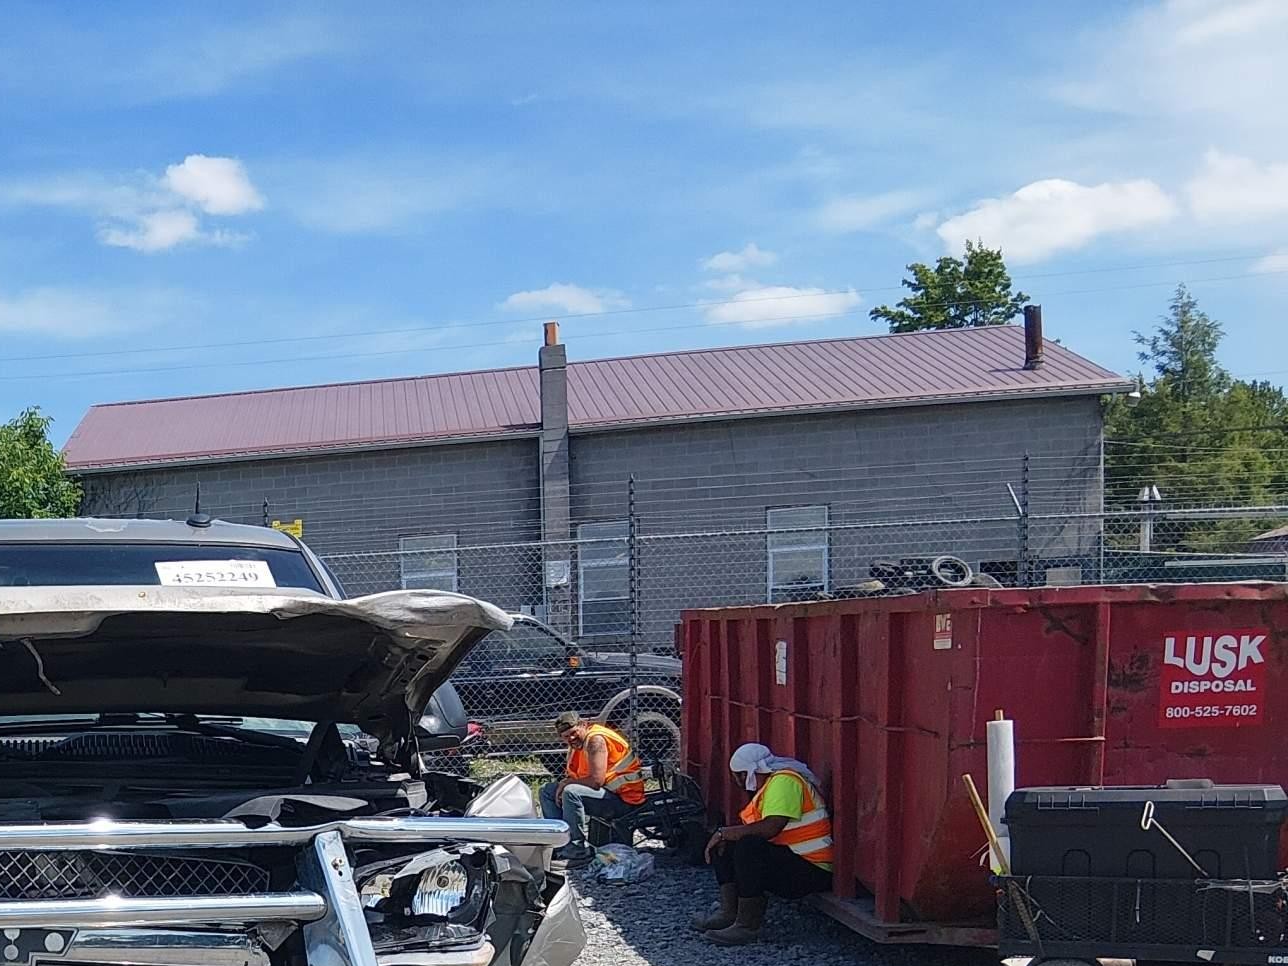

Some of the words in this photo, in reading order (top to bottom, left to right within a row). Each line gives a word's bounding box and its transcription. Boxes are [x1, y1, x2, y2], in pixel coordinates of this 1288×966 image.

[171, 570, 260, 584] 45252249
[1163, 635, 1267, 678] LUSK
[1170, 679, 1257, 694] DISPOSAL
[1165, 704, 1258, 718] 800-525-7602
